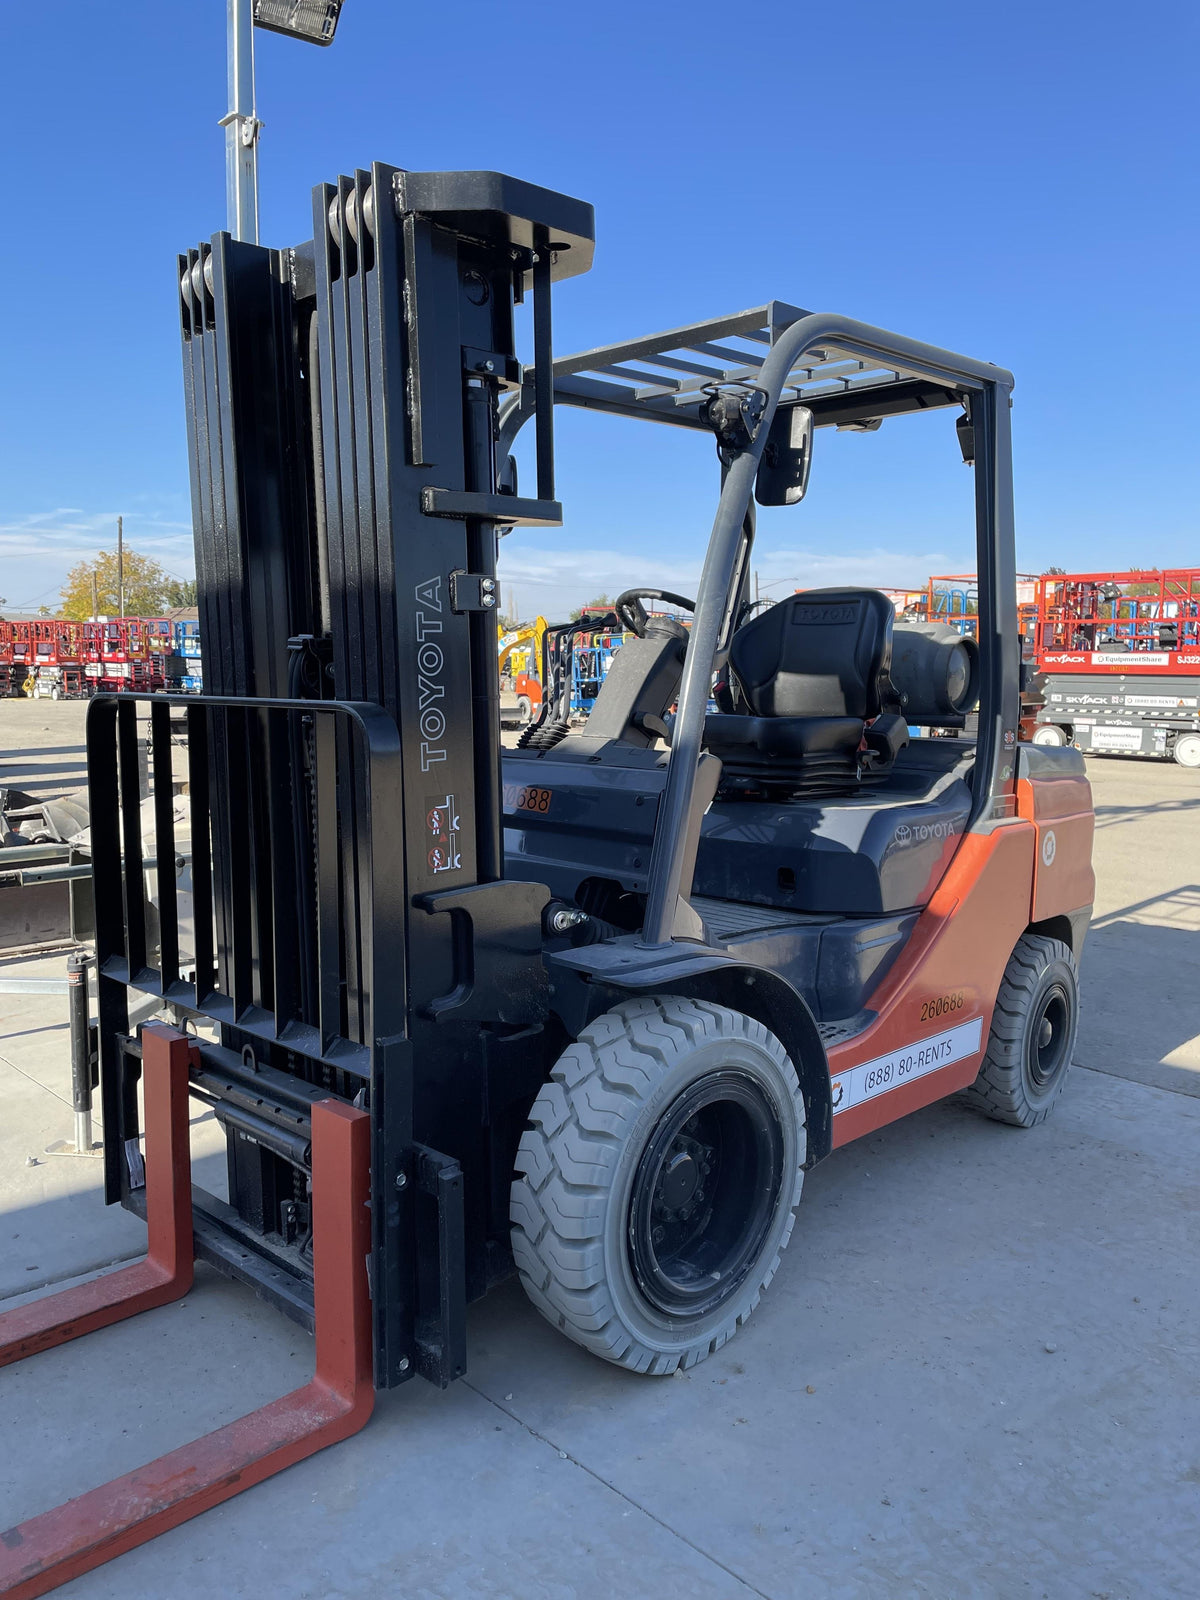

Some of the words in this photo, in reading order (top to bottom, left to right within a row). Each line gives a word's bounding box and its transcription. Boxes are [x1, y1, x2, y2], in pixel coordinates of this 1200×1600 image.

[800, 607, 856, 620] TOYOTA
[1044, 654, 1086, 664] SKYJACK
[1105, 656, 1163, 664] EquipmentShare
[415, 576, 447, 772] TOYOTA
[1065, 694, 1108, 705] SKYJACK
[912, 822, 955, 841] TOYOTA
[920, 991, 965, 1022] 260688
[864, 1062, 895, 1094] (888)
[898, 1039, 953, 1076] 80-RENTS
